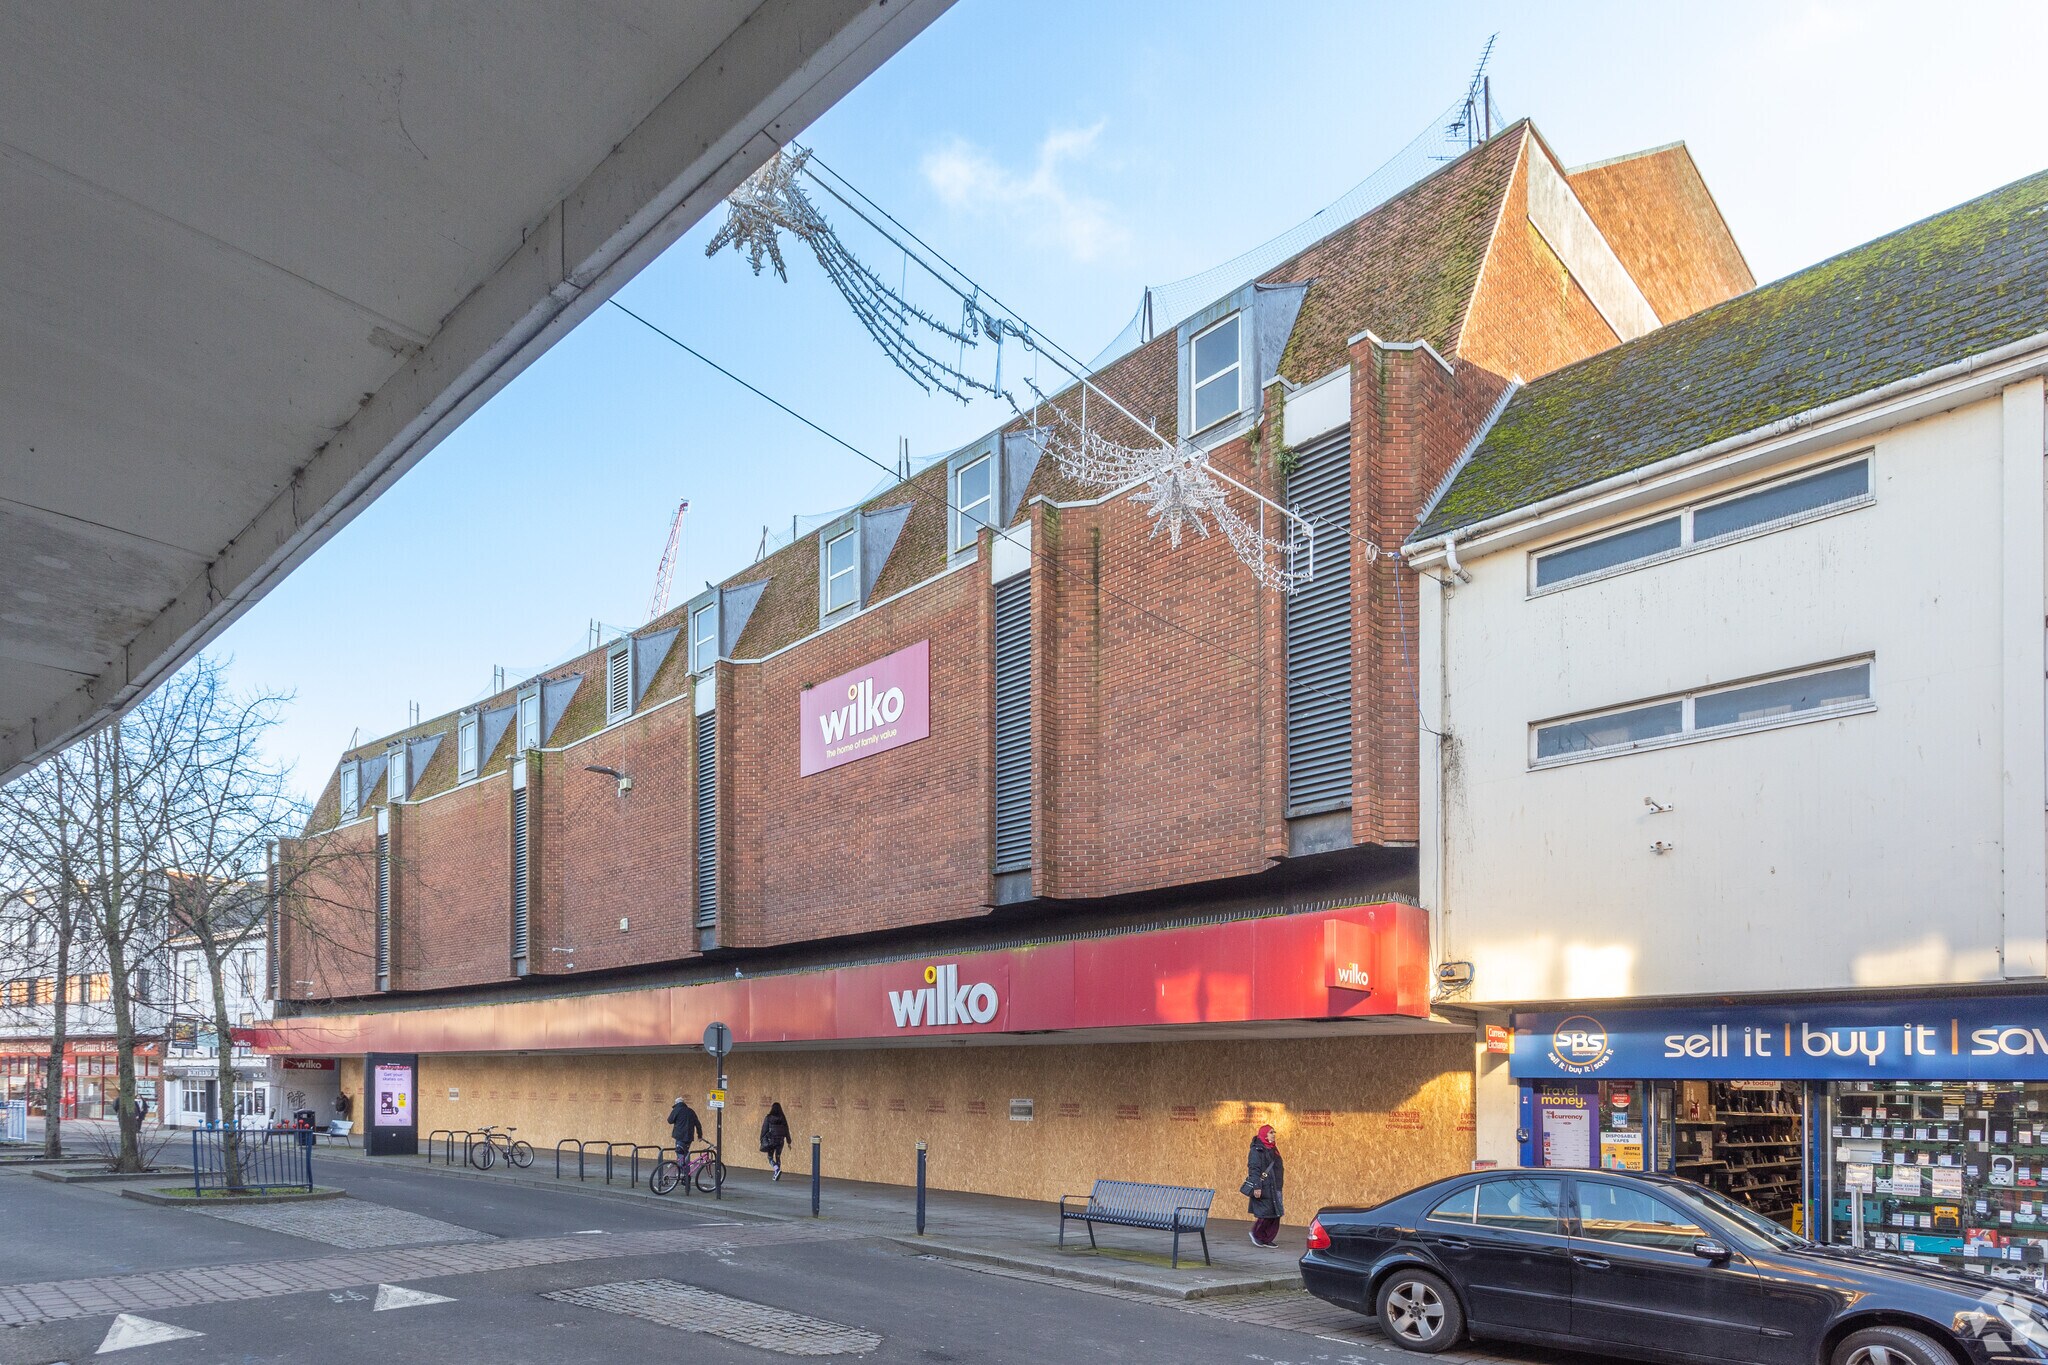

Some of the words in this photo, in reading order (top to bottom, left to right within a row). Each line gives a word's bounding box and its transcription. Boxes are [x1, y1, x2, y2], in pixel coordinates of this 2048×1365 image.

[819, 677, 905, 745] wilko
[826, 749, 836, 758] The
[836, 743, 853, 755] home
[854, 739, 861, 749] of
[861, 734, 879, 747] family
[880, 728, 897, 740] value
[1338, 963, 1368, 985] wilko
[888, 964, 998, 1028] wilko
[1488, 1028, 1508, 1040] Currency
[1556, 1031, 1605, 1051] SBS
[1664, 1024, 1728, 1058] sell
[1744, 1026, 1772, 1058] it
[1802, 1022, 1886, 1066] buy
[1904, 1022, 1936, 1056] it
[72, 1041, 100, 1053] Furniture
[1488, 1040, 1509, 1051] Exchange
[297, 1059, 322, 1069] wilko
[1548, 1052, 1560, 1065] sell
[1568, 1065, 1582, 1075] buy
[1593, 1055, 1610, 1070] save
[1540, 1085, 1578, 1096] Travel
[1541, 1096, 1587, 1109] money.
